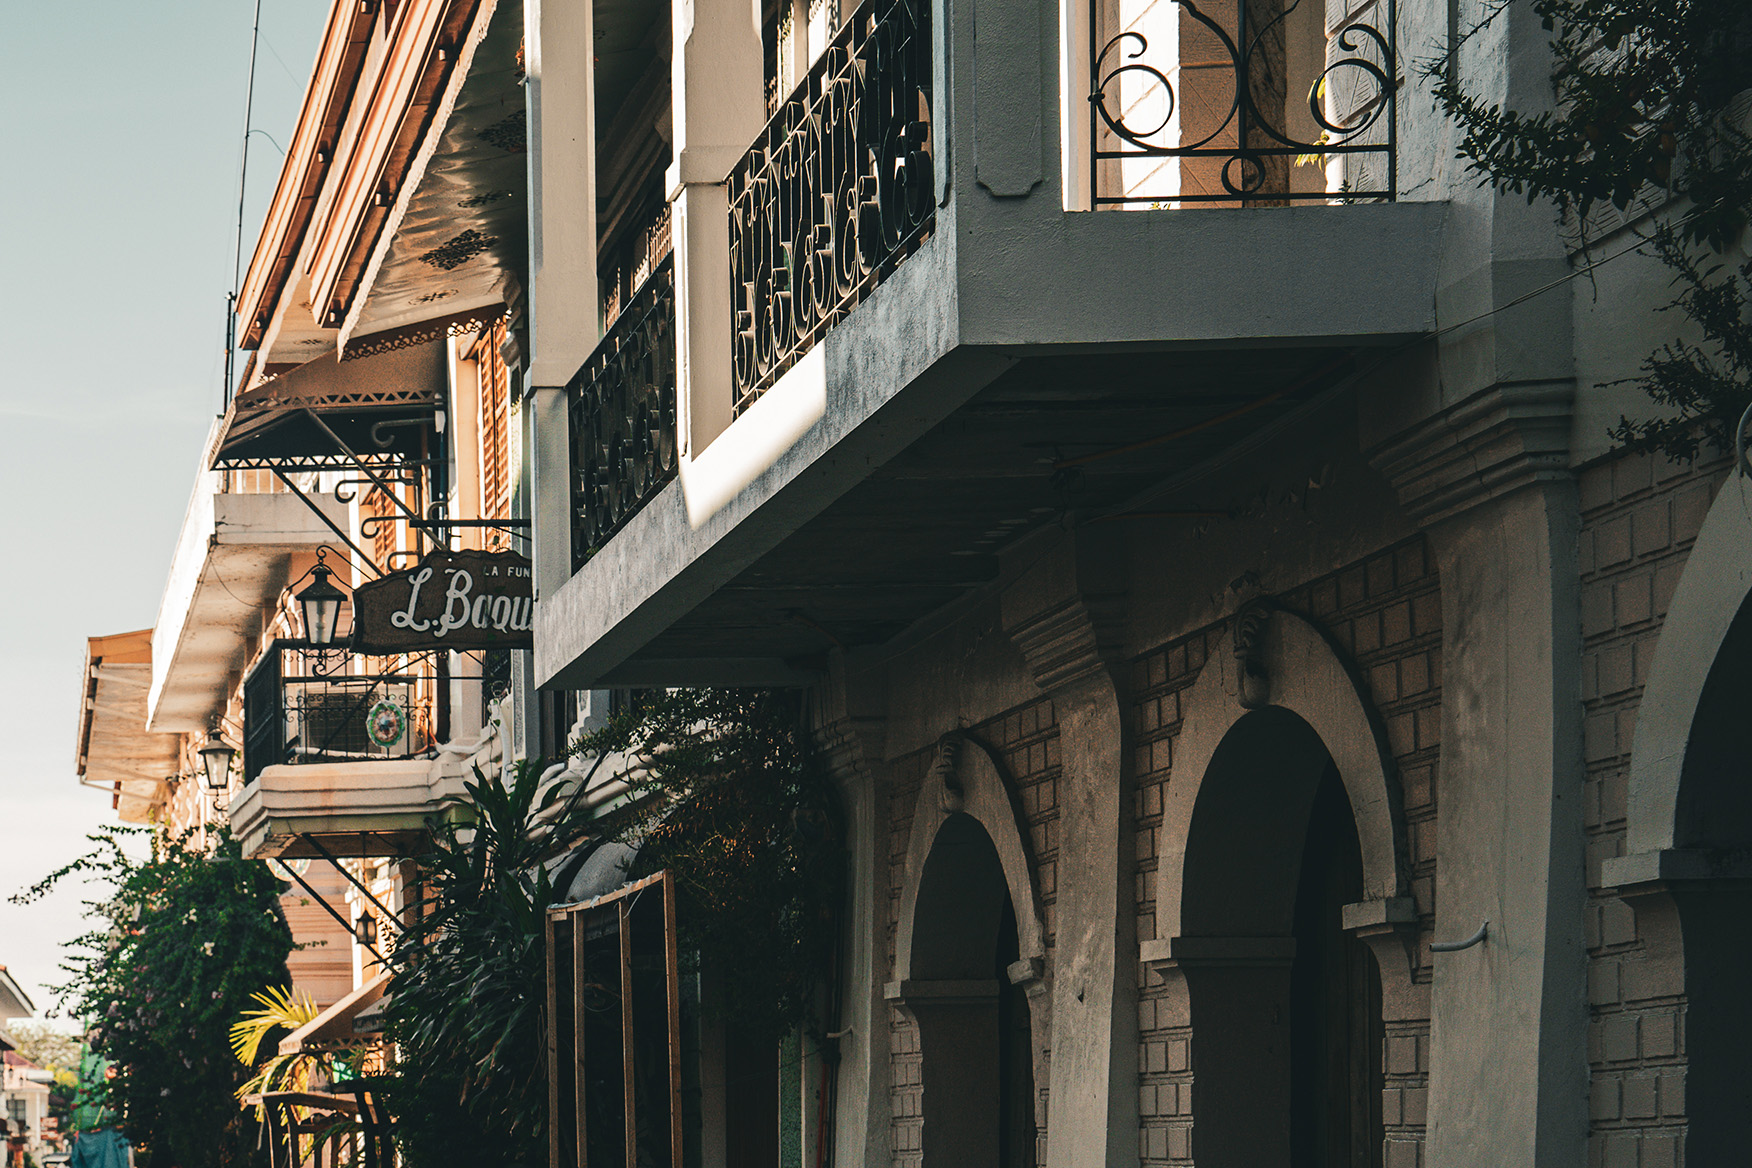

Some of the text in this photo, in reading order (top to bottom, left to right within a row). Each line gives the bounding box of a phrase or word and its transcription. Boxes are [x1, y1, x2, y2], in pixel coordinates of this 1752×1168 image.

[483, 566, 532, 578] LA FUN
[434, 568, 534, 638] Baqu
